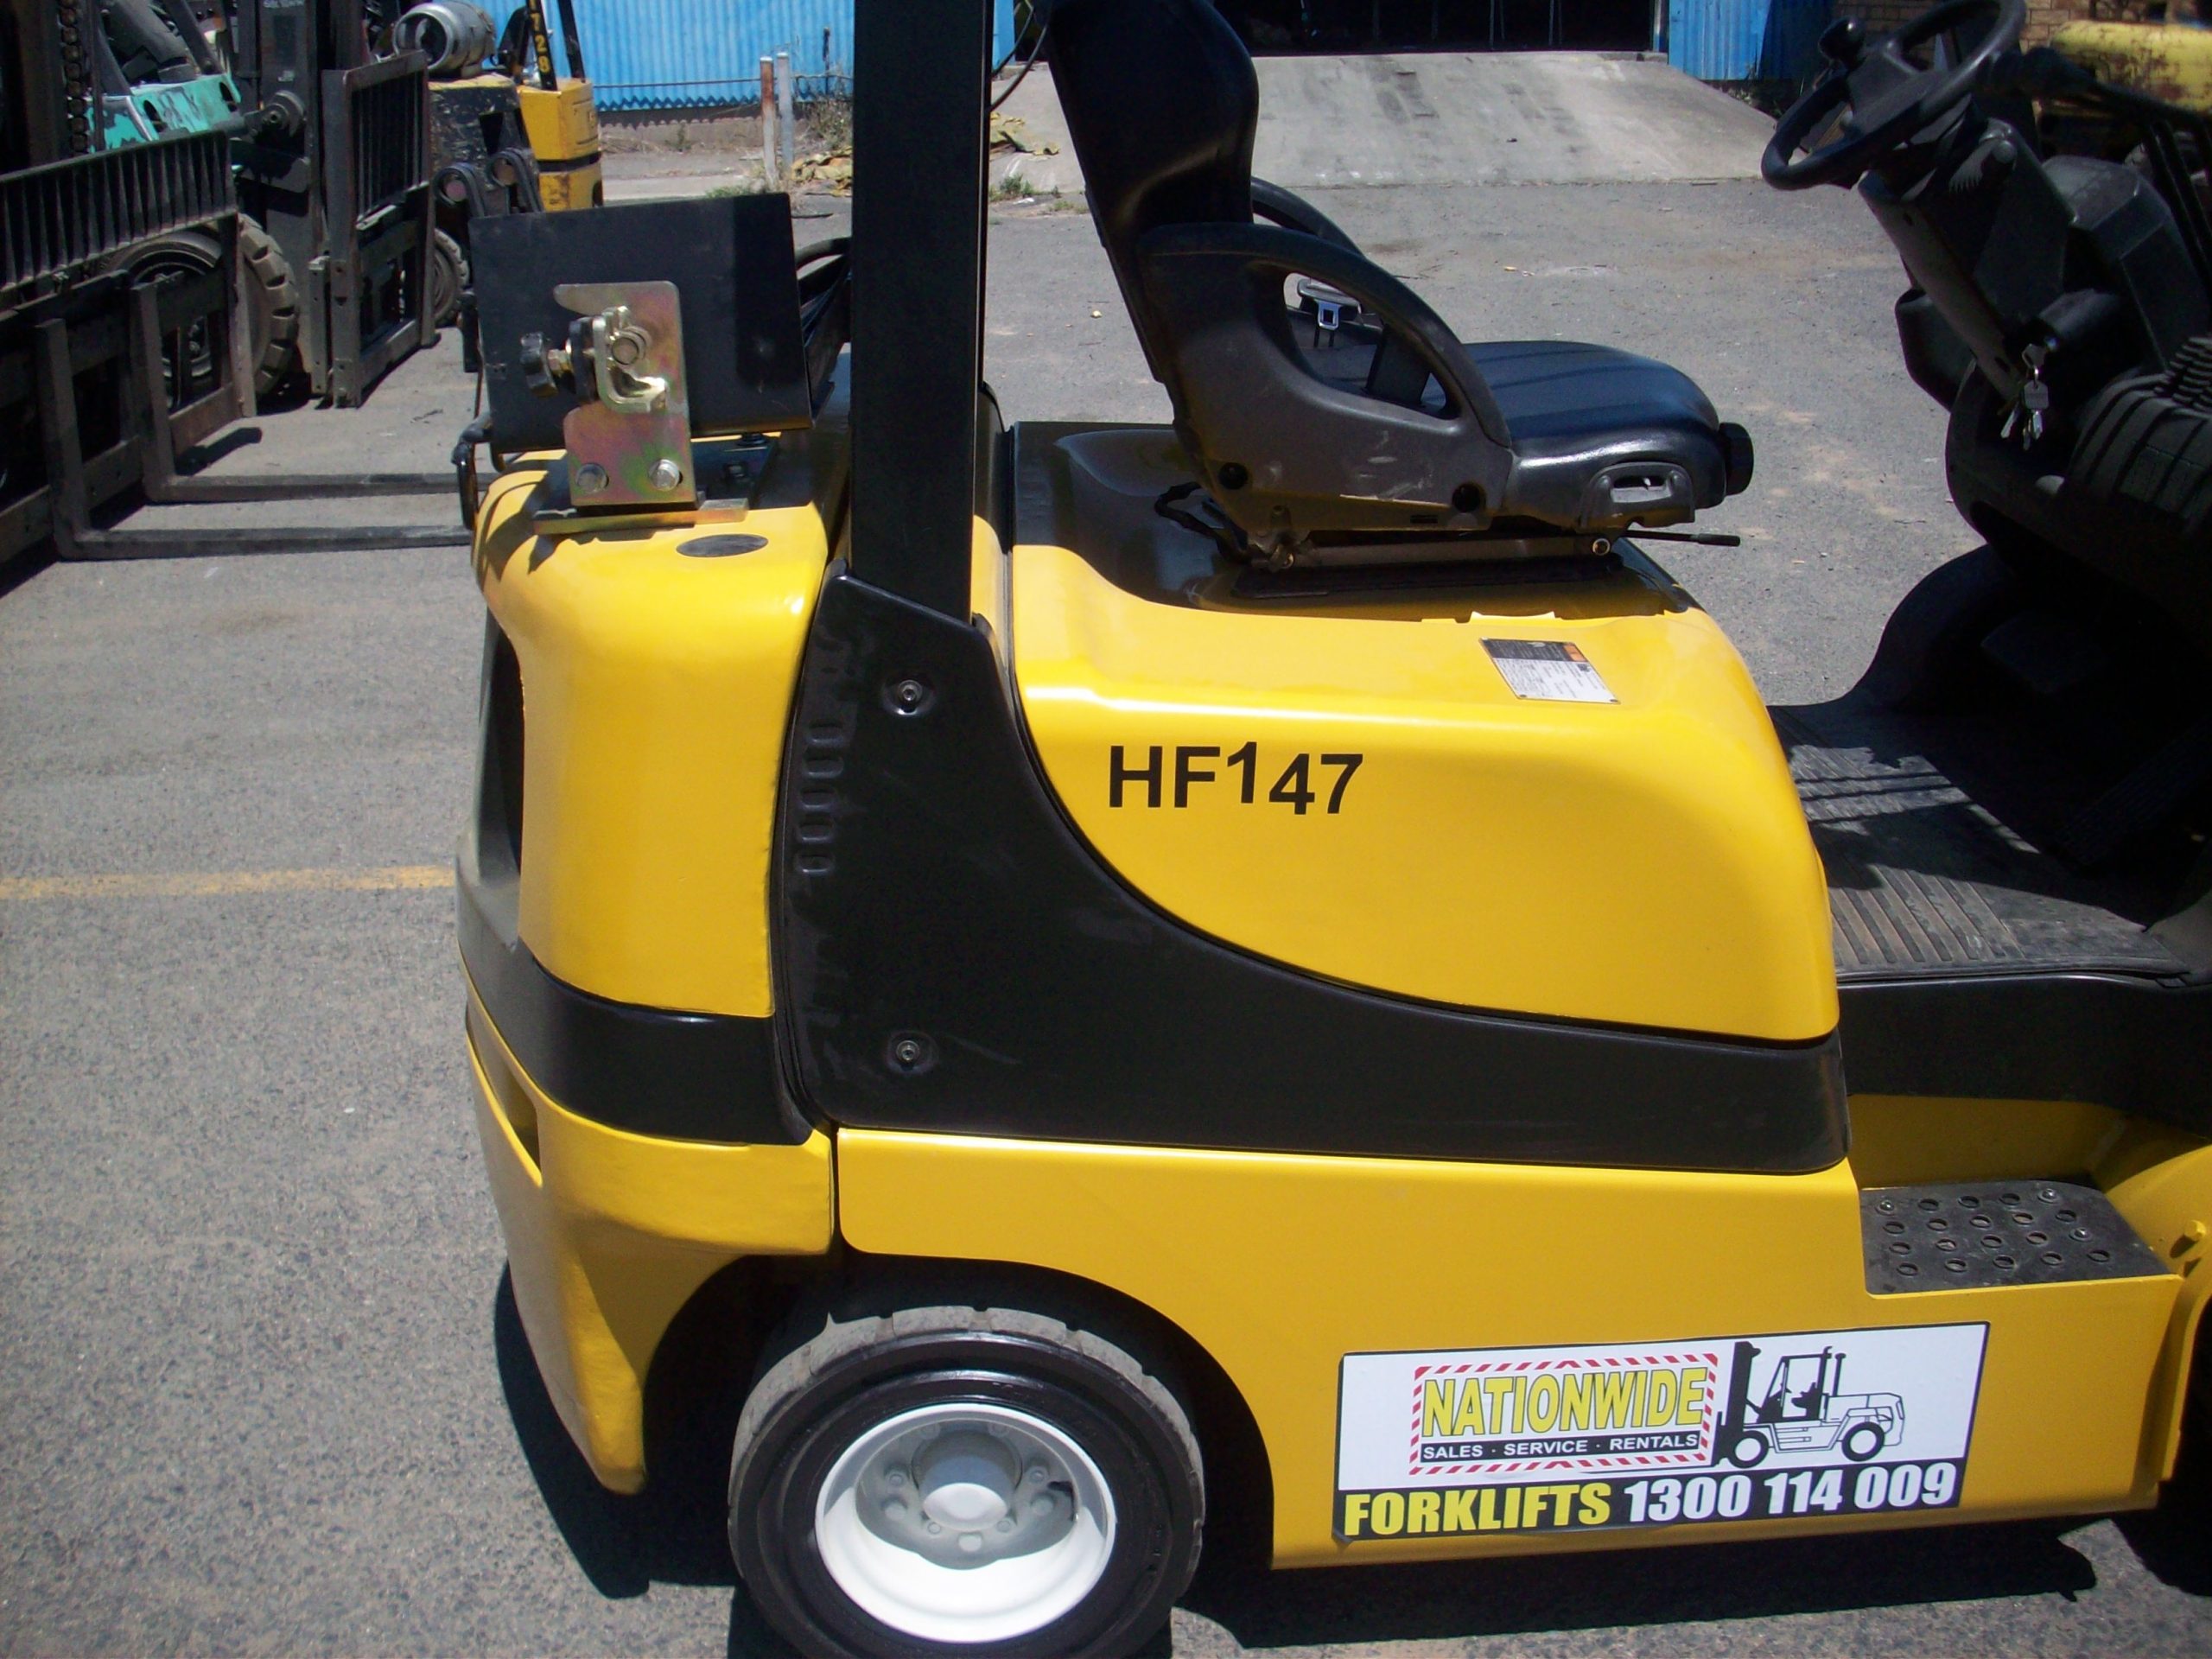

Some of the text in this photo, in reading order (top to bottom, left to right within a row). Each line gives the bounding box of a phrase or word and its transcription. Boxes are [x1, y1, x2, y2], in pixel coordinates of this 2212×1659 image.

[1109, 741, 1363, 815] HF147
[1421, 1367, 1708, 1437] NATIONWIDE
[1423, 1433, 1699, 1459] SALES SERVICE RENTALS
[1344, 1462, 1957, 1536] FORKLIFTS 1300 114 009
